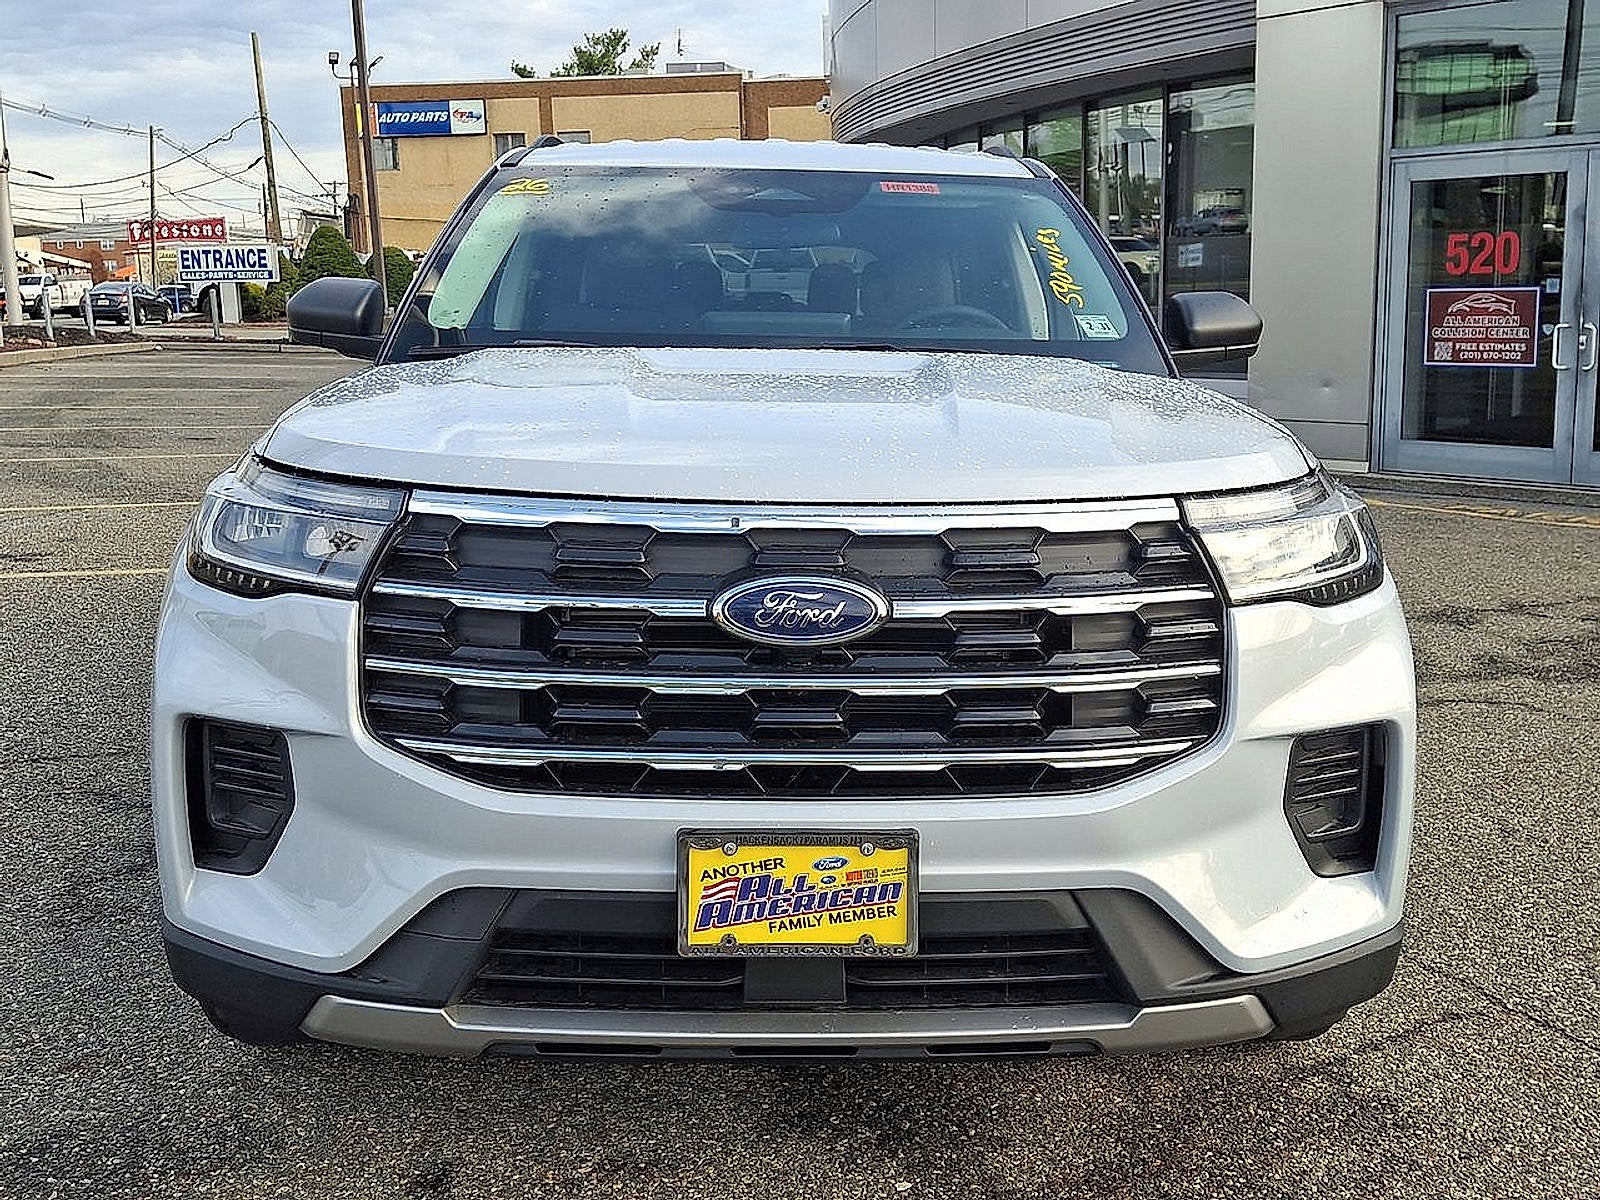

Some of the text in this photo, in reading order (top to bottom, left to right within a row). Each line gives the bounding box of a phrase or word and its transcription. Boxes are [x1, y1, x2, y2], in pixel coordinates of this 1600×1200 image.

[379, 112, 411, 123] AUTO
[410, 111, 449, 122] PARTS
[180, 248, 268, 270] ENTRANCE
[1445, 231, 1521, 275] 520
[1443, 316, 1520, 326] ALL AMERICAN
[1432, 328, 1530, 339] COLLISION CENTER
[1455, 342, 1526, 351] FREE ESTIMATES
[1460, 352, 1481, 360] (201)
[755, 591, 847, 628] Ford
[700, 857, 785, 882] ANOTHER
[737, 873, 818, 902] ALL
[697, 881, 903, 930] AMERICAN
[768, 905, 897, 934] FAMILY MEMBER
